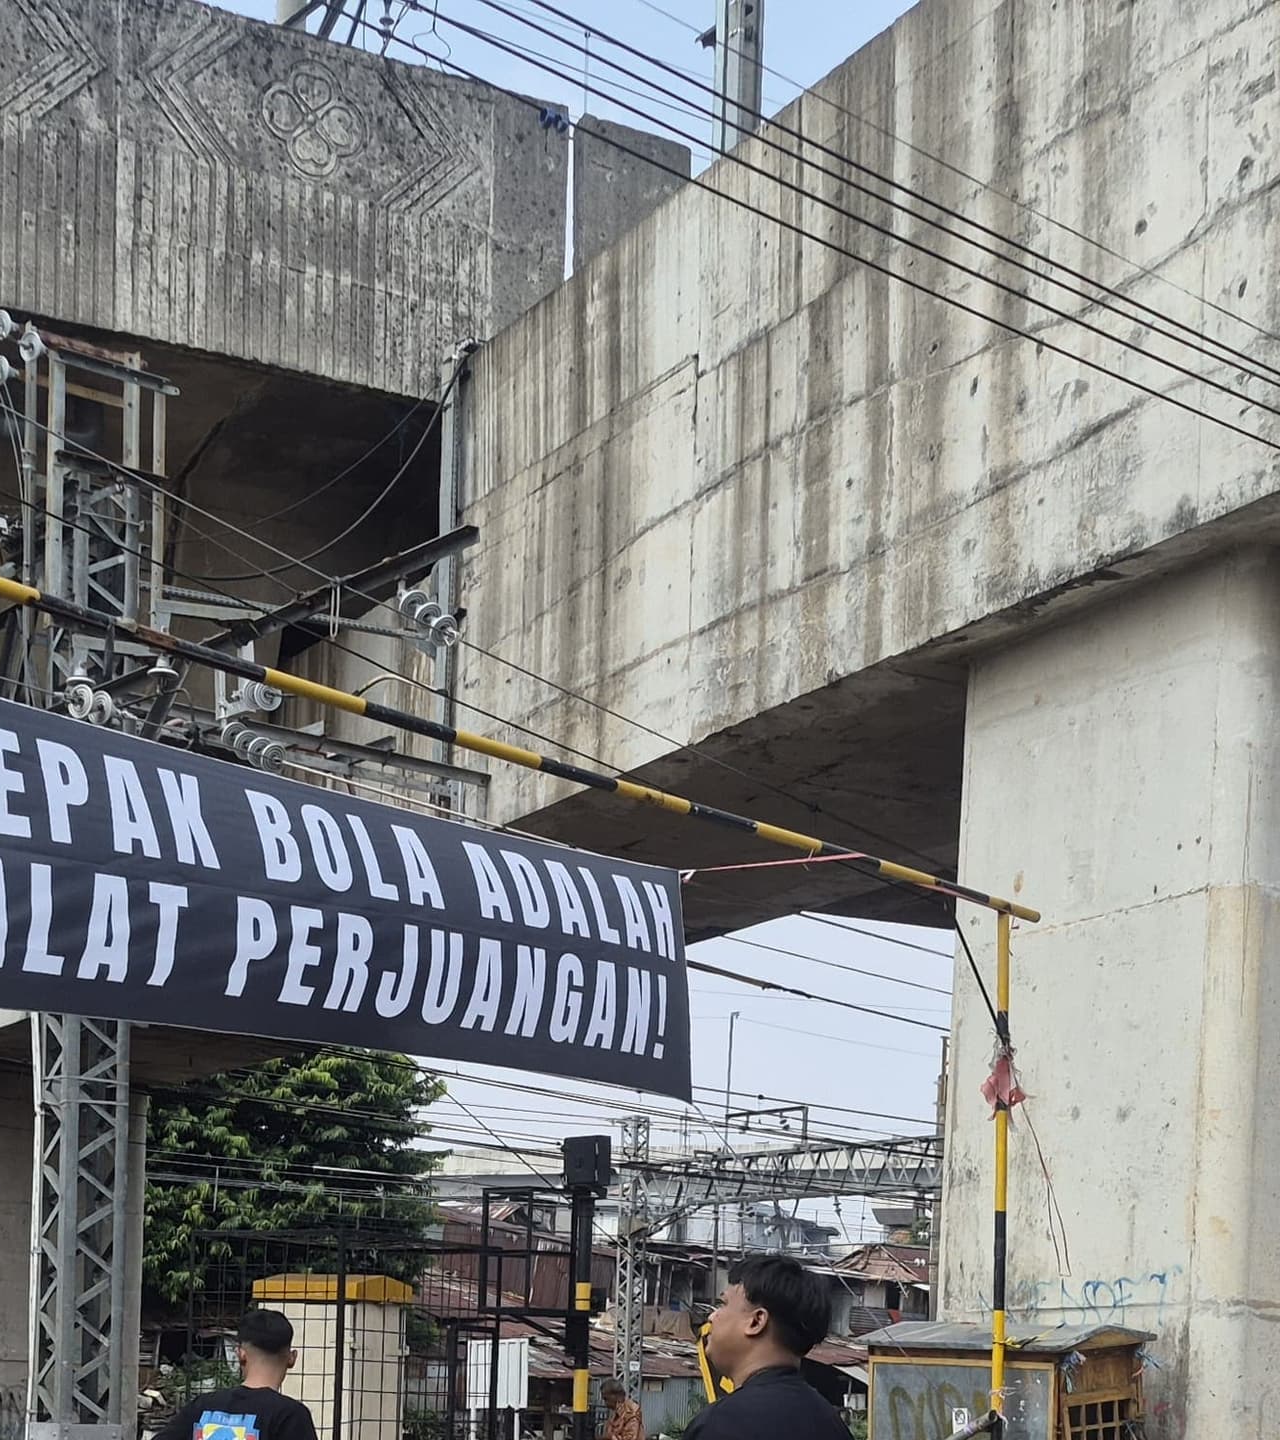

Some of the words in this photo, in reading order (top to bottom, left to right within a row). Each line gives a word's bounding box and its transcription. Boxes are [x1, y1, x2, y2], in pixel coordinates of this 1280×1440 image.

[245, 789, 446, 910] BOLA
[461, 840, 677, 962] ADALAH
[224, 896, 668, 1060] PERJUANGAN!
